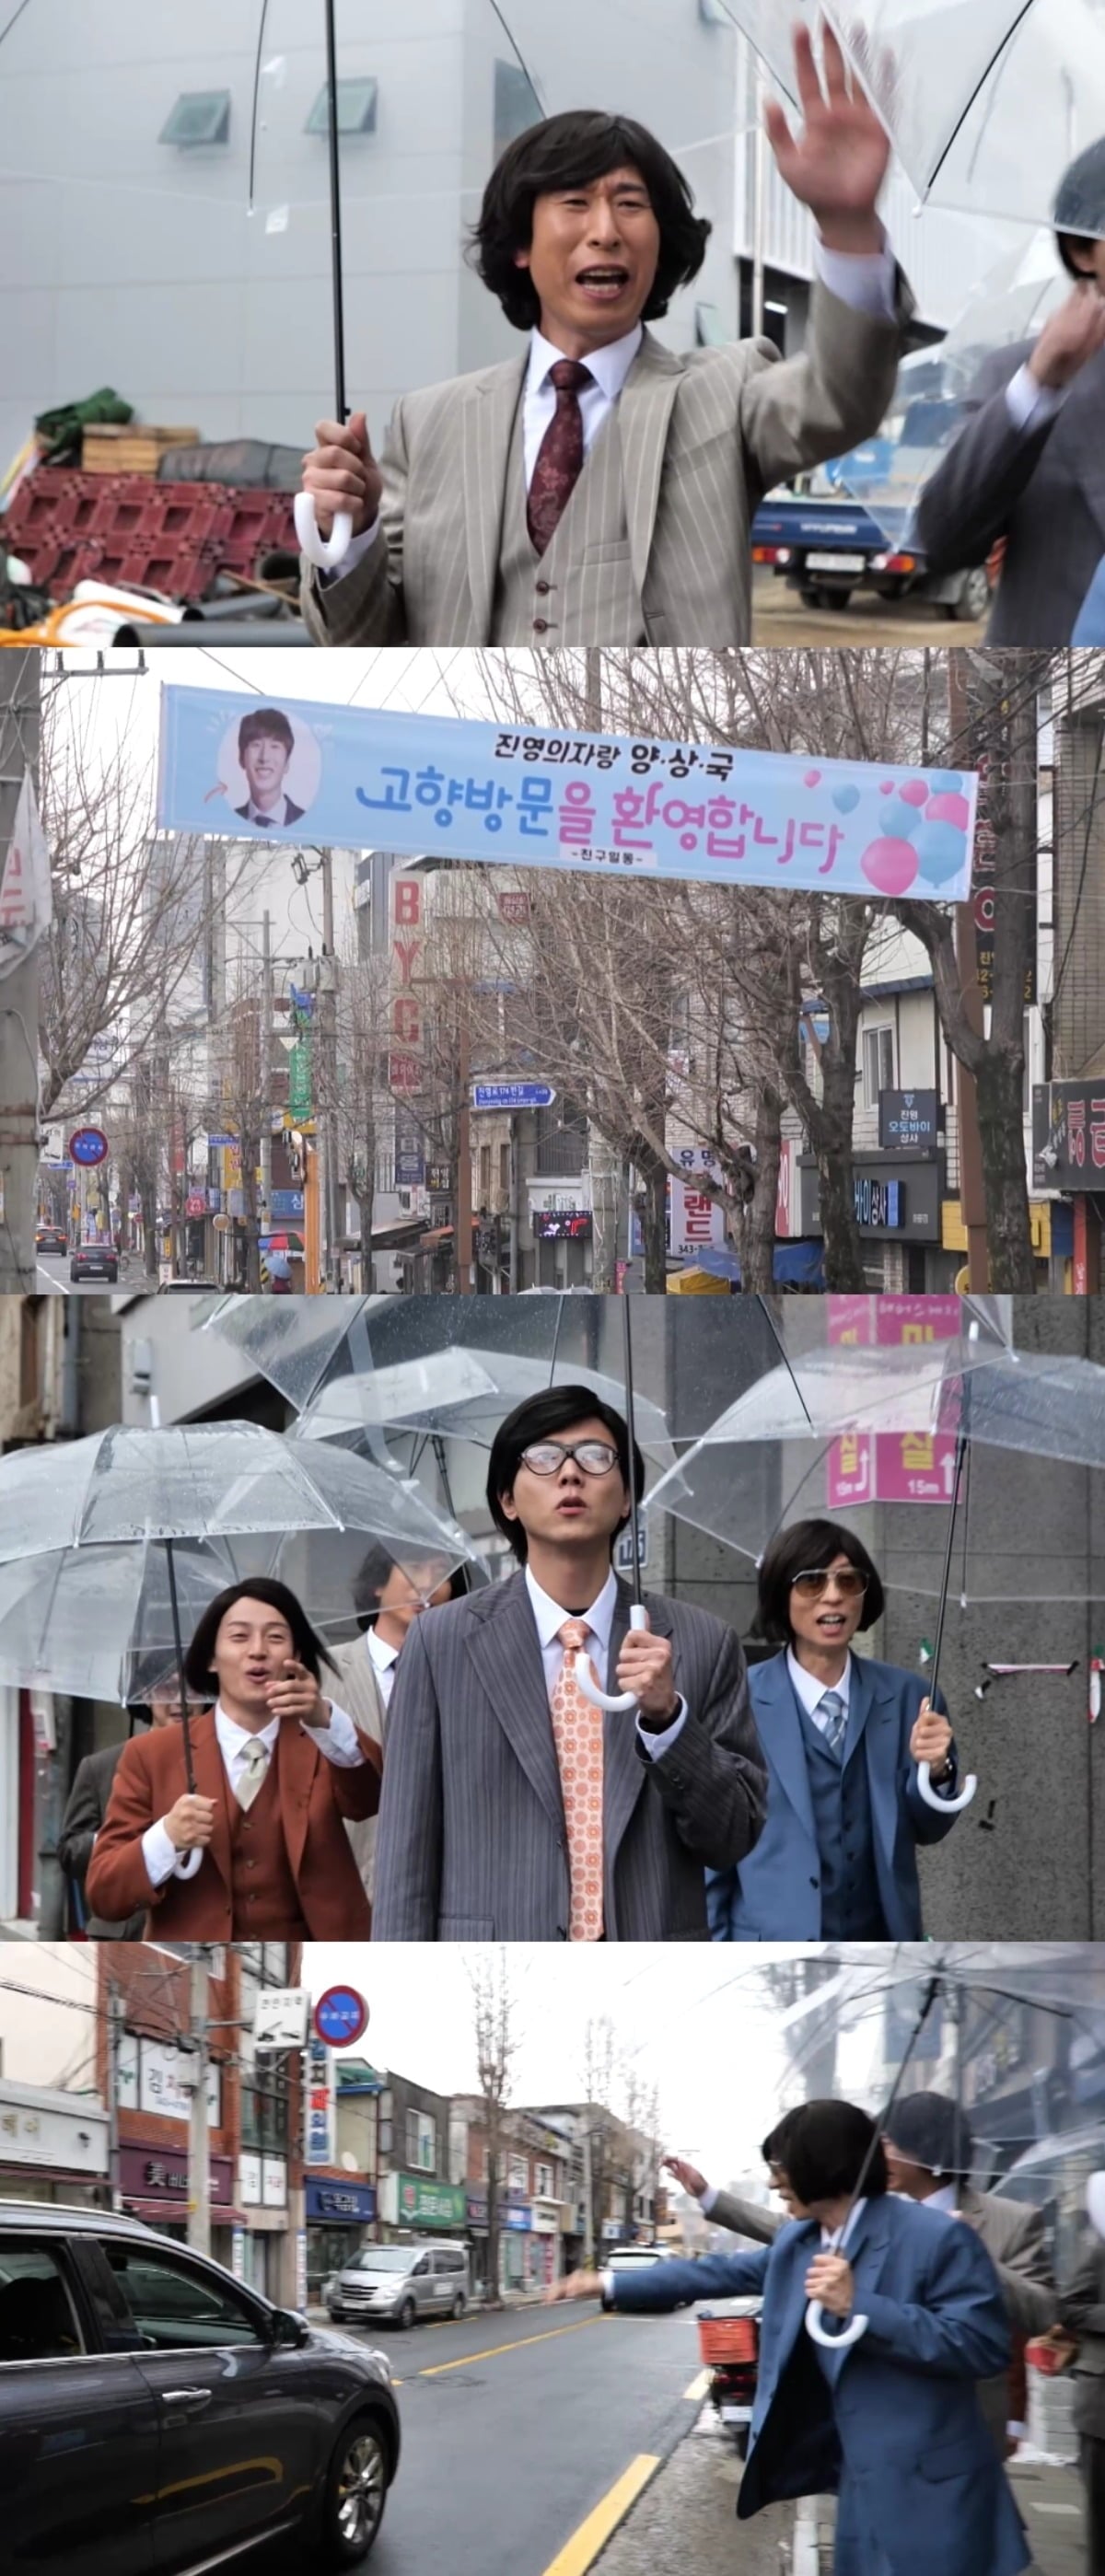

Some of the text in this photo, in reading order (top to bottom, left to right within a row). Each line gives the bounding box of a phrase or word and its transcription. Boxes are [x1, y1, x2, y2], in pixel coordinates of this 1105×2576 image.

[494, 733, 622, 769] 진영의자랑
[355, 764, 845, 876] 고향방문을 환영합니다
[393, 881, 421, 1043] BYC
[908, 1479, 939, 1494] 15m
